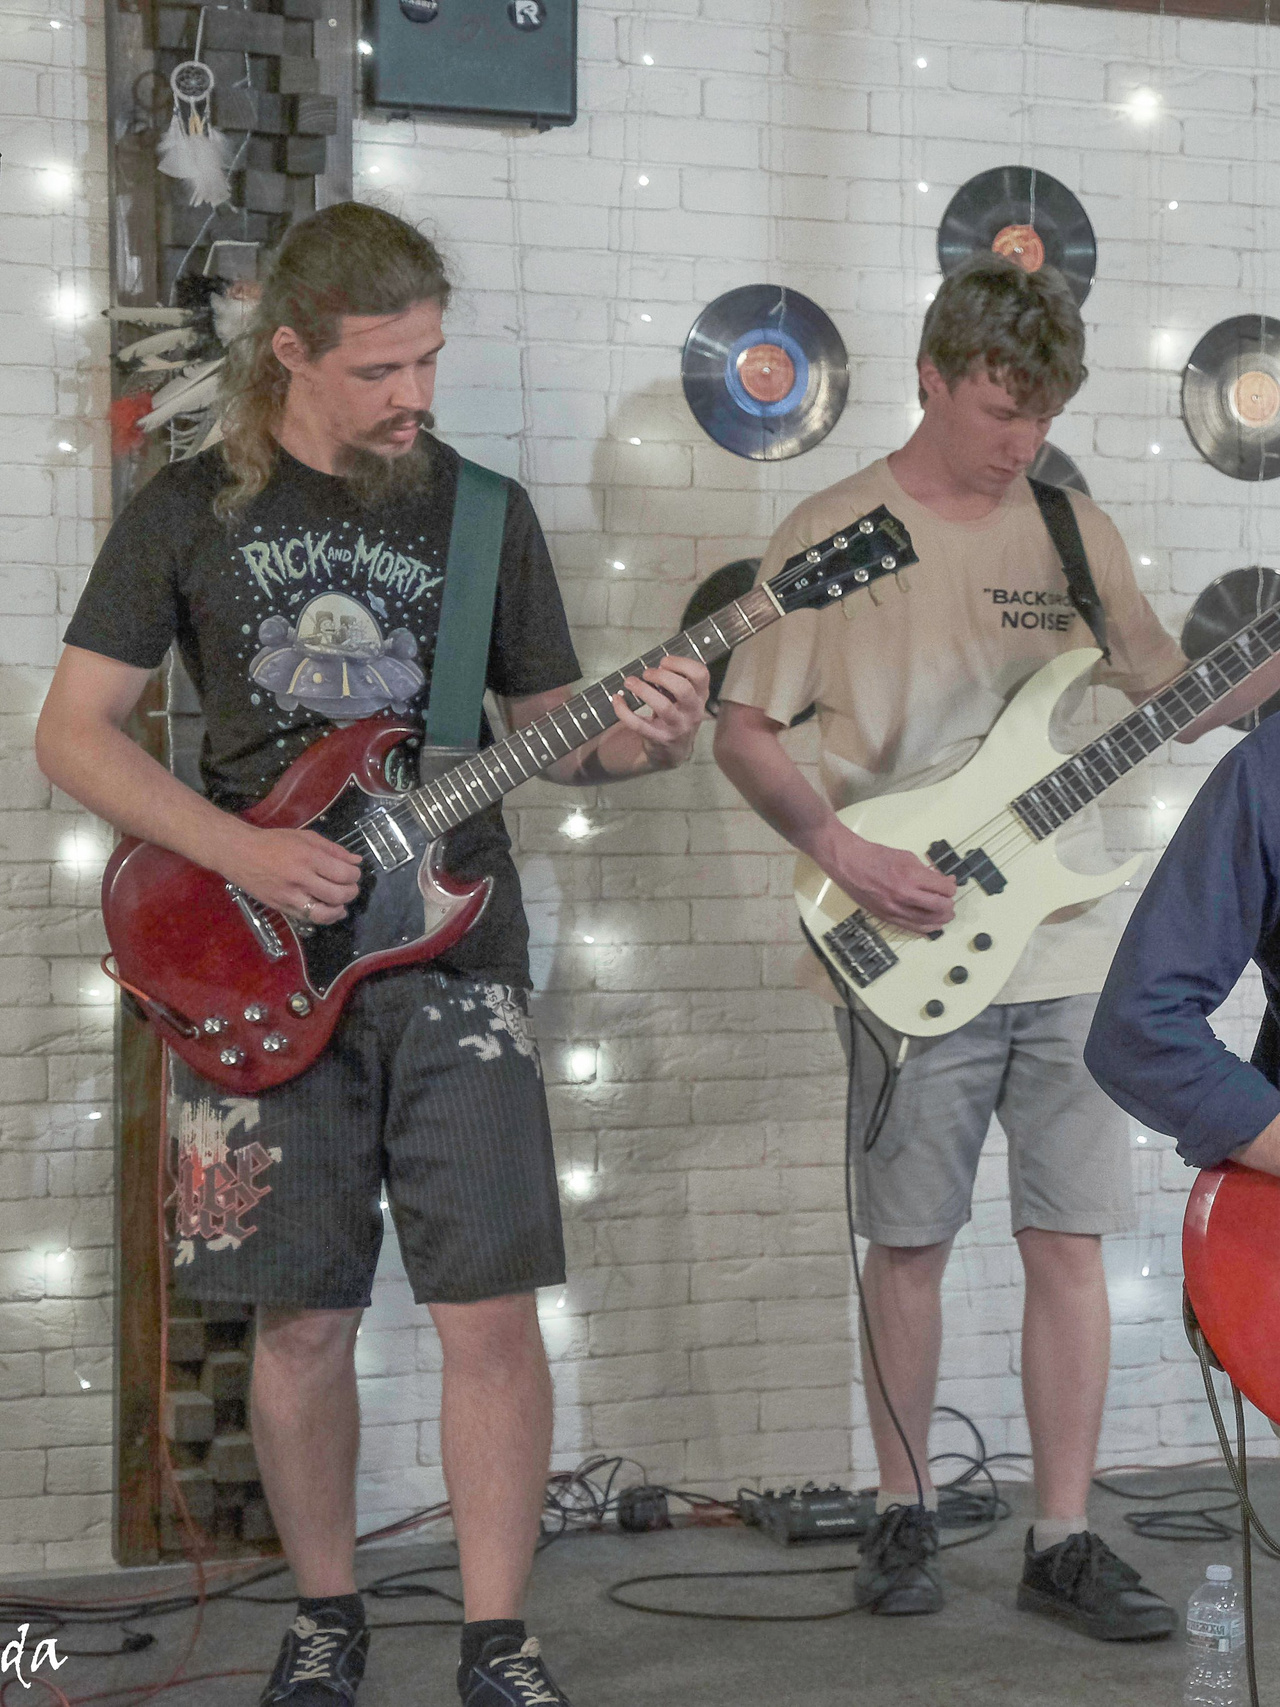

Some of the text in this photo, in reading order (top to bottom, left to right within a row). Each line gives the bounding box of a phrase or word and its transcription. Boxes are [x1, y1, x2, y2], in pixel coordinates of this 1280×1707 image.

[238, 531, 444, 603] RICK AND MORTY
[1001, 611, 1076, 631] NOISE"
